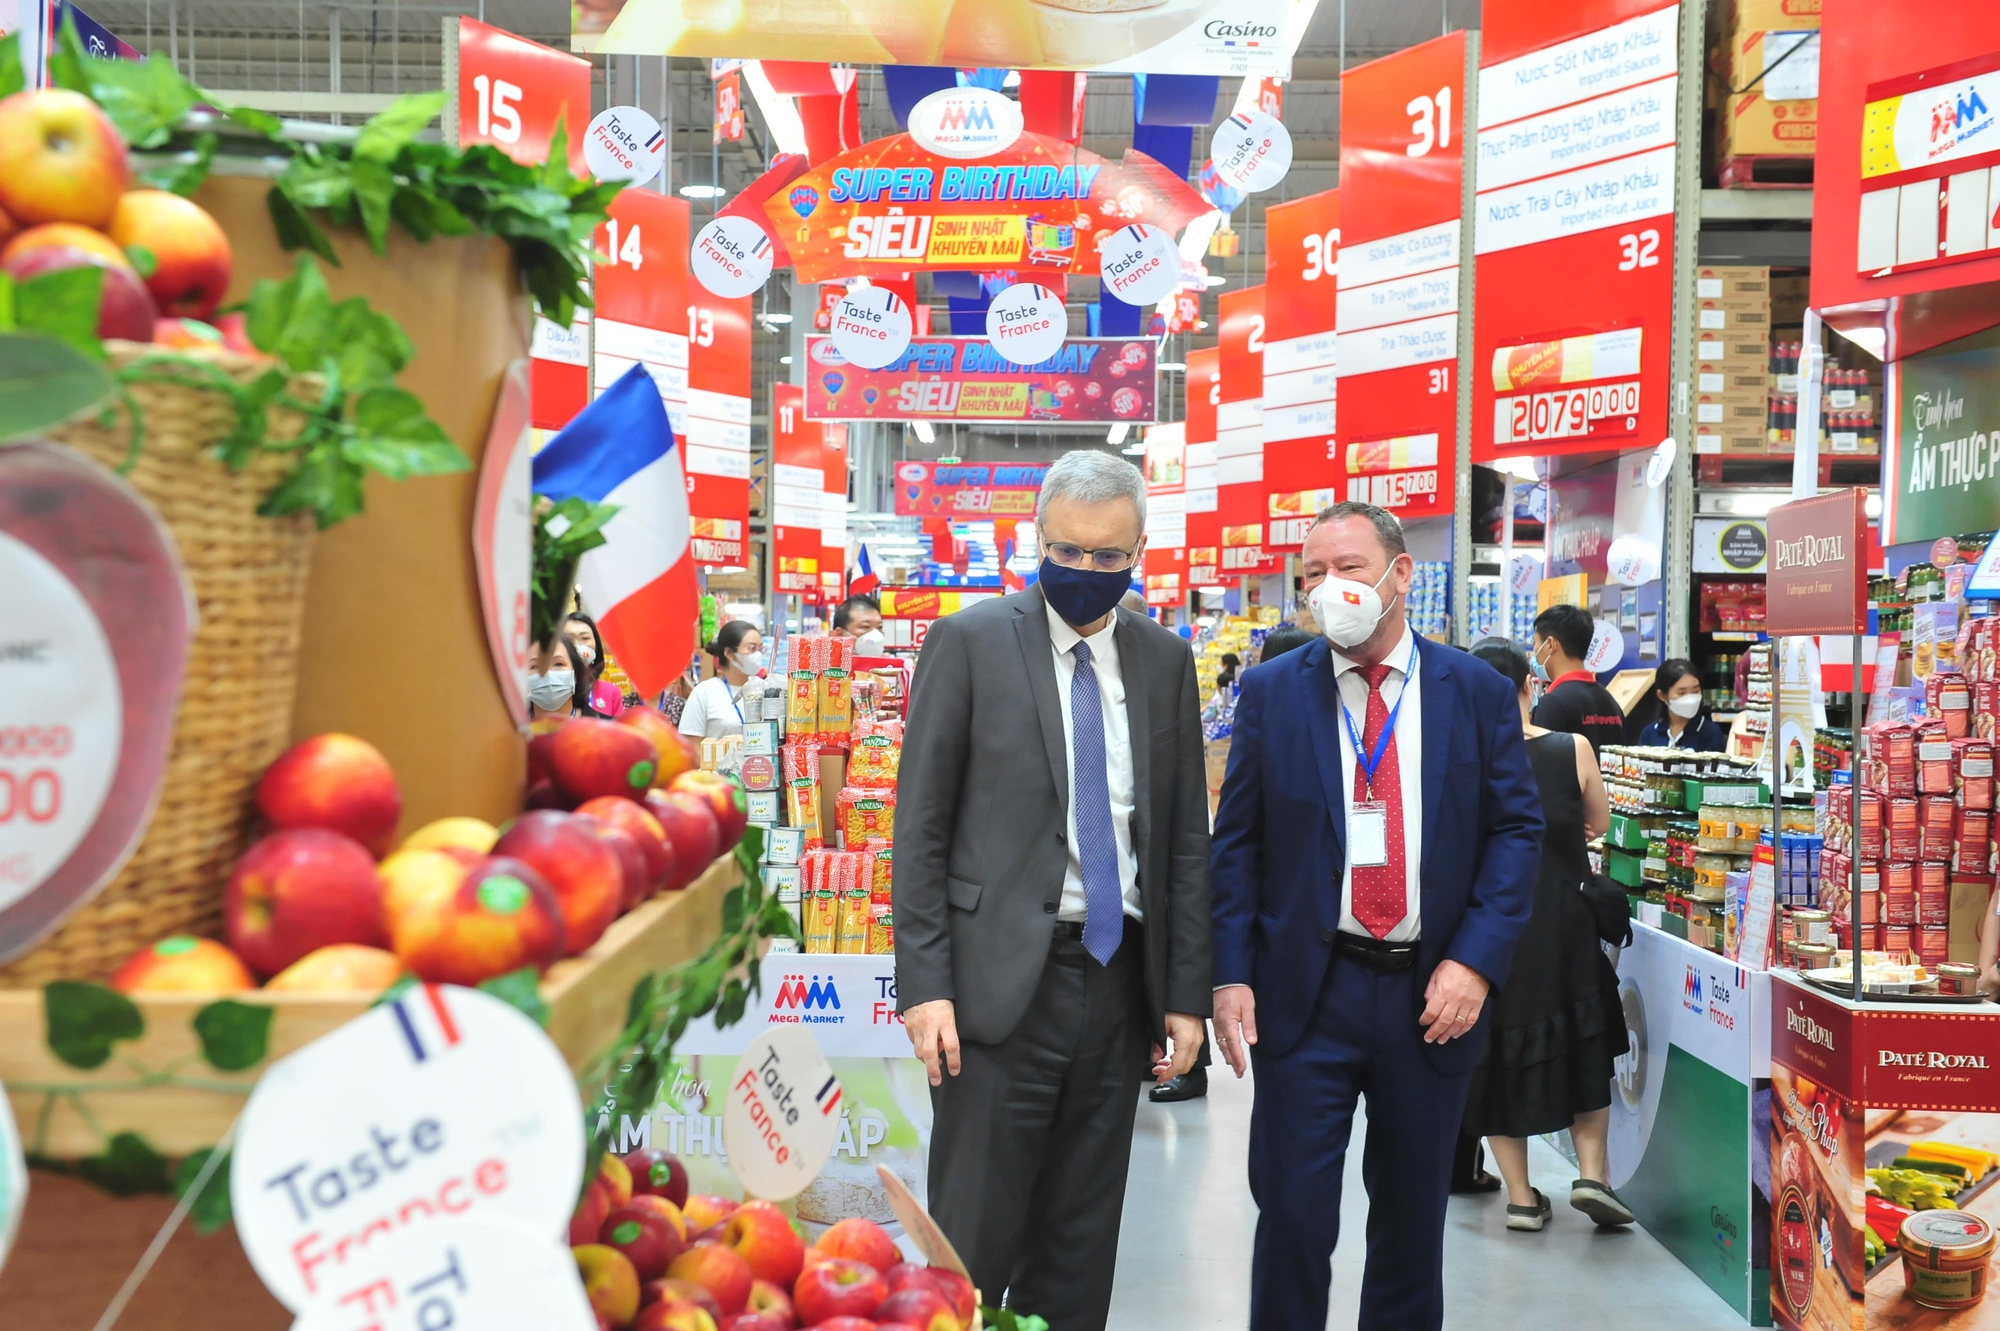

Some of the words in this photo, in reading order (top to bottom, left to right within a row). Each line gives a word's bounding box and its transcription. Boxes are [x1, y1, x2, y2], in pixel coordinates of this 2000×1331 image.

[1203, 20, 1277, 39] Casino
[1226, 49, 1246, 57] quality
[1230, 63, 1248, 72] 1901
[1579, 66, 1622, 87] Imported
[1624, 54, 1661, 73] Sauces
[473, 75, 522, 143] 15
[1406, 86, 1451, 157] 31
[608, 113, 638, 152] Taste
[1551, 142, 1592, 160] Imported
[1594, 128, 1630, 149] Canned
[1634, 121, 1660, 138] Good
[593, 125, 634, 170] France
[1221, 136, 1254, 172] Taste
[1234, 138, 1272, 184] France
[829, 167, 934, 203] SUPER
[939, 164, 1102, 202] BIRTHDAY
[1560, 206, 1602, 227] Imported
[1604, 201, 1628, 217] Fruit
[1631, 195, 1658, 212] Juice
[840, 206, 932, 259] SIÊU
[935, 220, 970, 236] SINH
[971, 216, 1006, 240] NHẬT
[606, 218, 642, 271] 14
[699, 237, 743, 278] France
[711, 225, 745, 261] Taste
[932, 237, 986, 256] KHUYẾN
[991, 236, 1020, 256] MÃI
[1302, 228, 1340, 281] 30
[1618, 229, 1660, 271] 32
[1104, 250, 1144, 277] Taste
[1112, 258, 1160, 292] France
[687, 305, 714, 347] 13
[842, 301, 882, 323] Taste
[996, 305, 1038, 324] Taste
[836, 316, 887, 341] France
[999, 319, 1050, 340] France
[548, 344, 572, 360] Cooking
[1414, 348, 1434, 358] Herbal
[1435, 346, 1447, 356] Tea
[1428, 366, 1449, 394] 31
[1519, 358, 1556, 386] PROMOTION
[897, 375, 961, 412] SIÊU
[960, 396, 1002, 412] KHUYẾN
[1004, 397, 1024, 412] MÃI
[963, 386, 986, 397] SINH
[988, 384, 1016, 400] NHẬT
[779, 405, 794, 434] 11
[933, 466, 990, 486] SUPER
[1909, 432, 1937, 494] ẨM
[1940, 430, 1987, 492] THỰC
[953, 486, 992, 511] SIÊU
[1803, 534, 1845, 568] ROYAL
[1516, 565, 1534, 590] France
[1815, 580, 1832, 594] France
[1590, 636, 1611, 668] France
[793, 671, 816, 680] PANZANI
[824, 670, 848, 678] PANZANI
[863, 738, 892, 747] PANZANI
[1890, 732, 1913, 740] Casino
[791, 779, 815, 788] PANZANI
[856, 800, 884, 810] PANZANI
[1711, 975, 1730, 1004] Taste
[1710, 1000, 1734, 1031] France
[1786, 1007, 1808, 1038] PATÉ
[1807, 1017, 1835, 1052] ROYAL
[1878, 1050, 1926, 1067] PATÉ
[1926, 1051, 1990, 1069] ROYAL
[670, 1066, 713, 1106] hoa
[758, 1044, 799, 1126] Taste
[1898, 1073, 1931, 1083] Fabriqué
[1944, 1075, 1972, 1083] France
[735, 1069, 790, 1166] France
[264, 1117, 444, 1222] Taste
[1710, 1205, 1738, 1239] Casino
